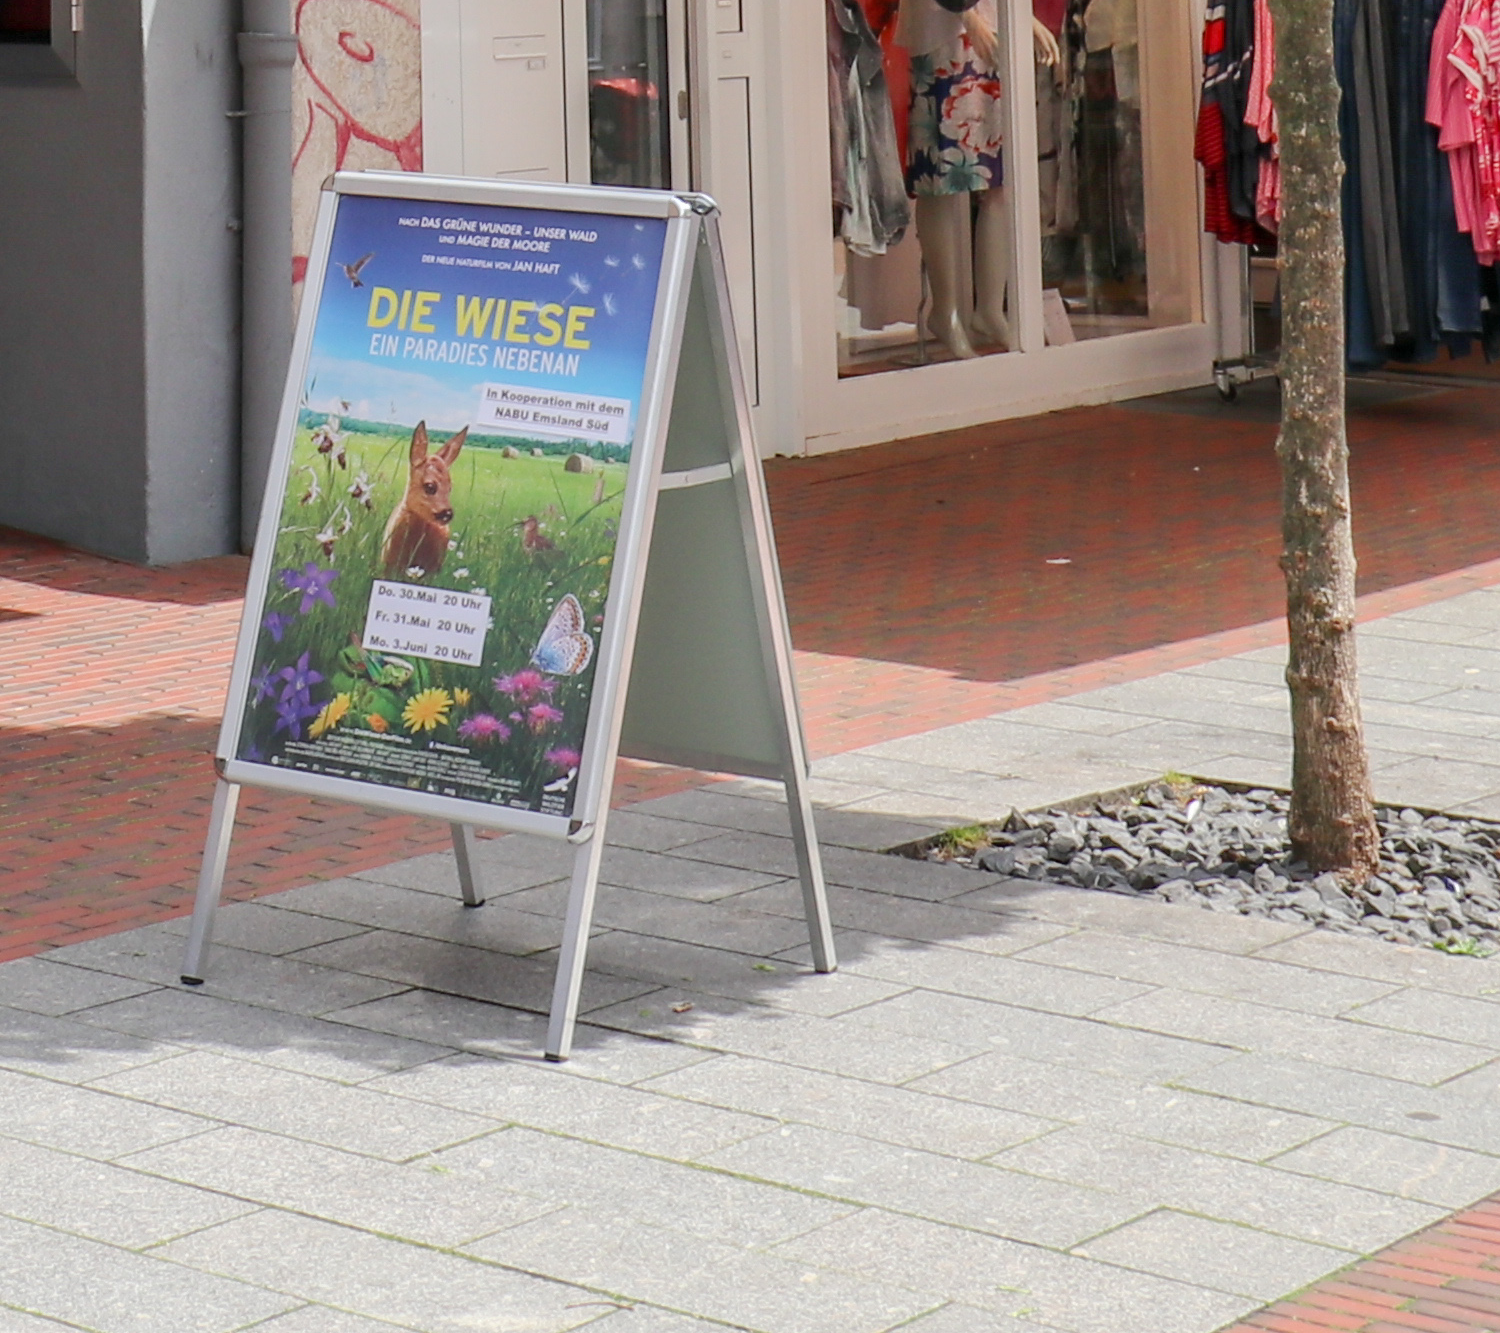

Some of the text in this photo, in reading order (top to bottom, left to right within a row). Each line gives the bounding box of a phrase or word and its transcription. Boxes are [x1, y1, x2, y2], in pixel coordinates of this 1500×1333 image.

[421, 216, 441, 229] DAS
[442, 217, 478, 232] GRÜNE
[479, 222, 523, 236] WUNDER
[534, 227, 566, 240] UNSER
[569, 229, 598, 243] WALD
[456, 234, 490, 248] MAGIE
[492, 238, 510, 249] DER
[512, 239, 551, 253] MOORE
[421, 254, 435, 264] DER
[436, 256, 455, 266] NEUE
[512, 261, 533, 273] JAN
[535, 262, 561, 275] HAFT
[366, 286, 596, 350] DIE WIESE
[369, 333, 580, 377] EIN PARADIES NEBENAN
[486, 387, 625, 416] In Kooperation mit dem
[495, 407, 610, 432] NABU Emsland Süd
[378, 585, 482, 611] Do. 30.Mai 20 Uhr
[375, 610, 476, 635] Fr. 31.Mai 20 Uhr
[370, 635, 473, 661] Mo. 3.Juni 20 Uhr
